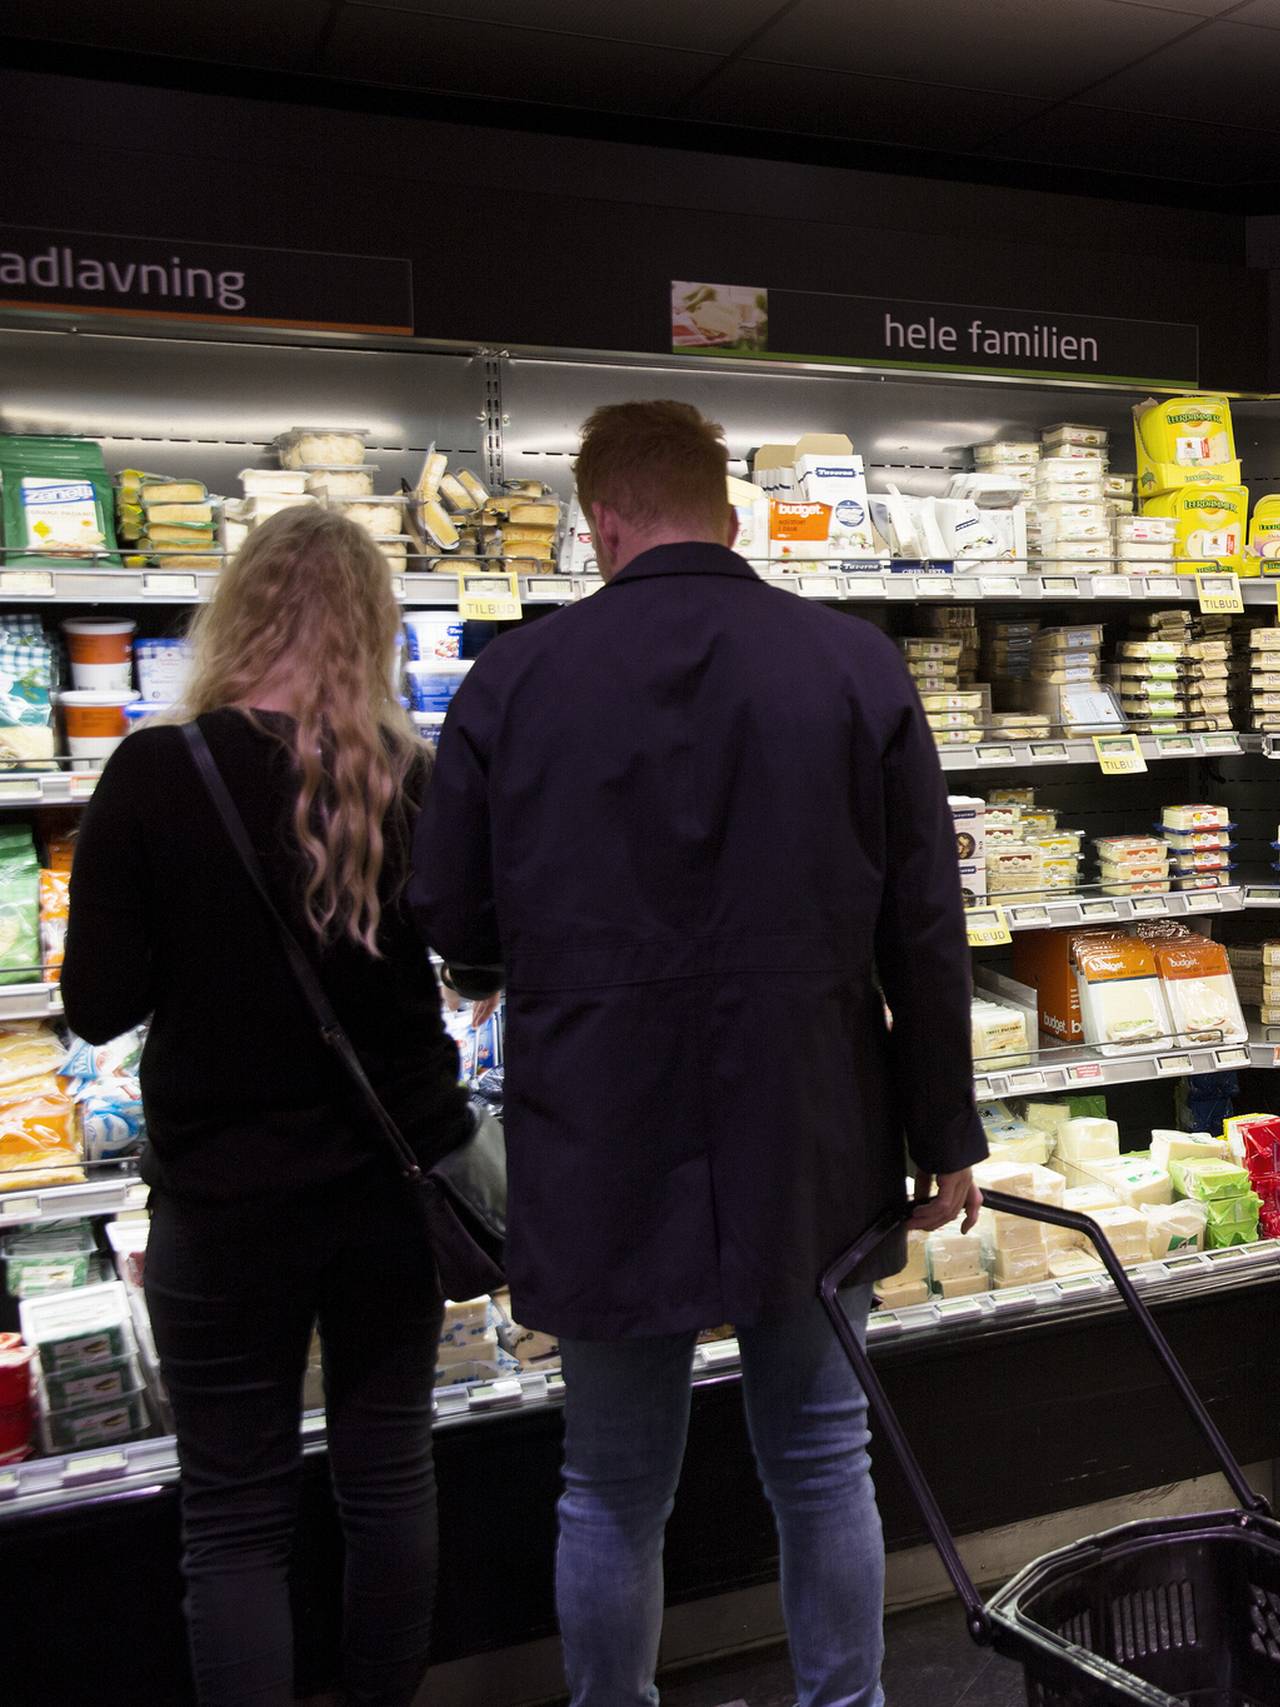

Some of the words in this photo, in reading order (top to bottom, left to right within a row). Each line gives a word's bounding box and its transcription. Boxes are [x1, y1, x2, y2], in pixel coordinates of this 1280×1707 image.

[0, 246, 247, 311] adlavning
[884, 312, 957, 351] hele
[969, 319, 1098, 362] familien
[1167, 413, 1222, 425] LEERDAMMER
[778, 503, 824, 519] budget.
[1184, 499, 1238, 514] LEERDAMMER
[466, 603, 516, 615] TILBUD
[1203, 600, 1239, 609] TILBUD
[967, 931, 1006, 941] TILBUD
[1169, 956, 1200, 968] budget.
[1043, 1012, 1068, 1034] budget.
